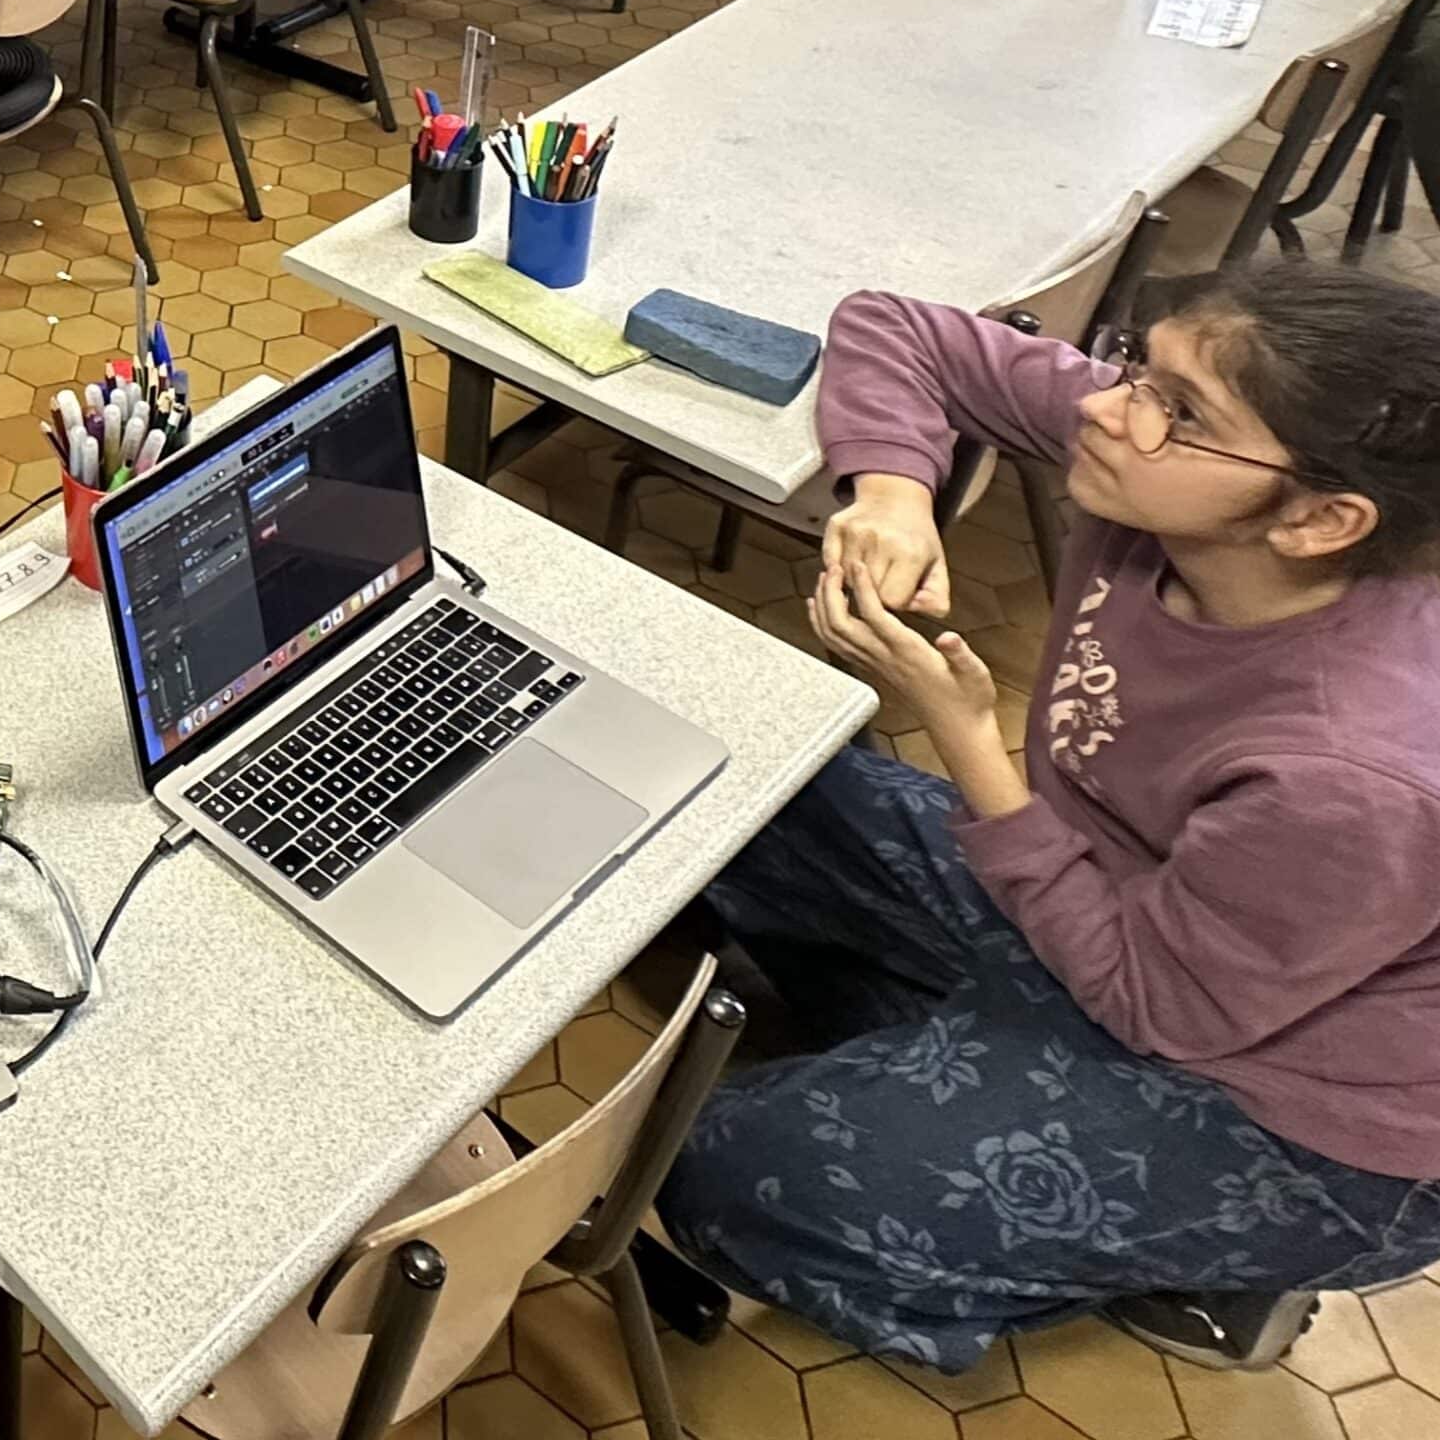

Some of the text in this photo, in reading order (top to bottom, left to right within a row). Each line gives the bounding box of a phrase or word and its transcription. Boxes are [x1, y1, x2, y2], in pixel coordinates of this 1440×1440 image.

[0, 571, 17, 587] 7
[17, 563, 35, 577] 8
[34, 553, 51, 567] 9
